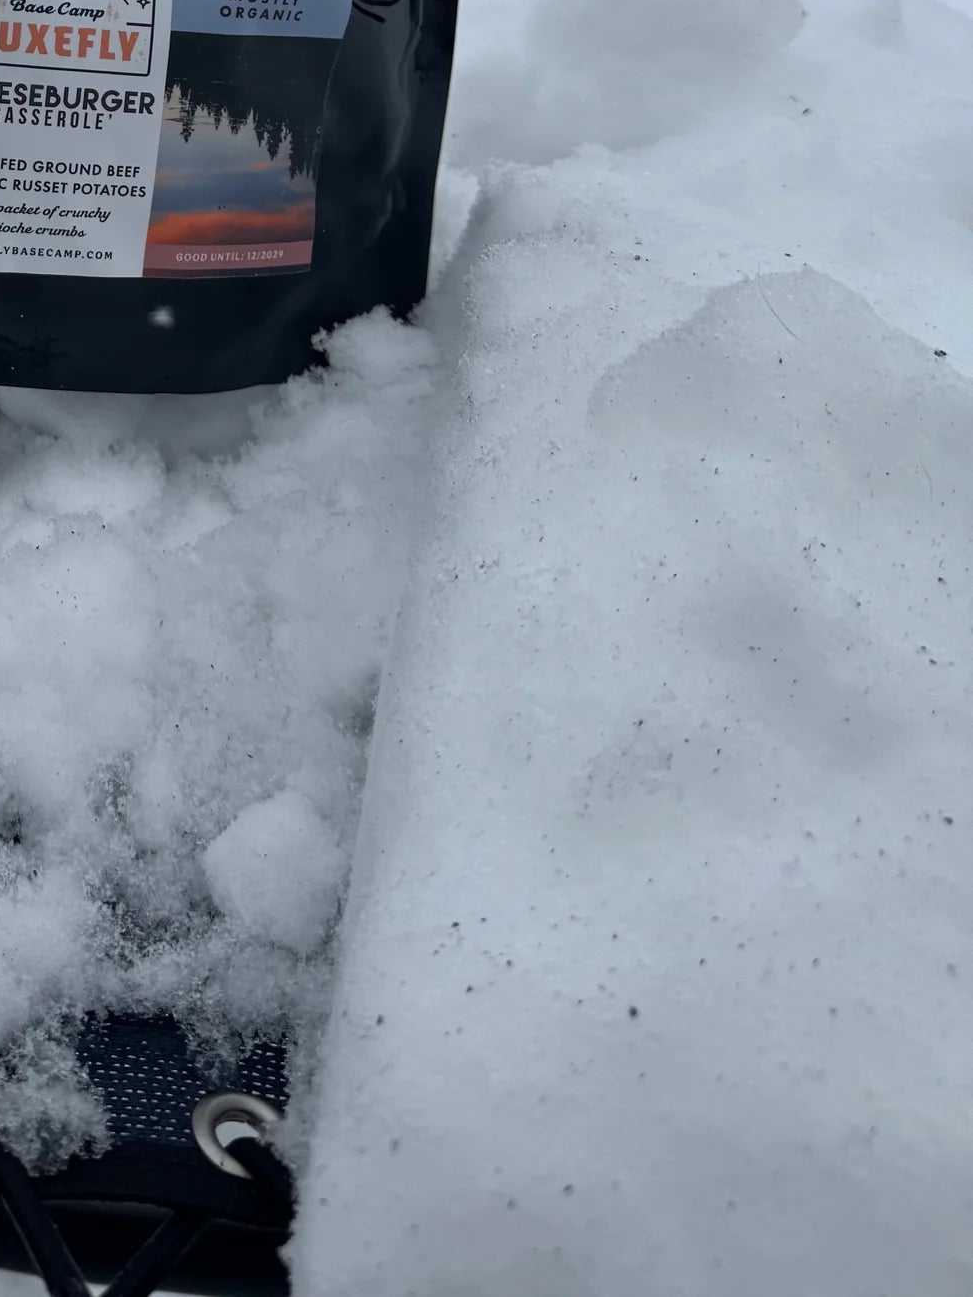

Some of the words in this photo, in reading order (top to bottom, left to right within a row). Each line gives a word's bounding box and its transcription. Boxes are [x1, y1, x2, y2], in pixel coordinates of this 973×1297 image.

[57, 2, 105, 22] Camp
[219, 5, 304, 22] ORGANIC
[0, 158, 27, 171] FED
[32, 160, 102, 176] GROUND
[107, 165, 141, 178] BEEF
[12, 179, 69, 194] RUSSET
[73, 182, 147, 198] POTATOES
[42, 205, 60, 220] of
[59, 207, 111, 223] crunchy
[35, 225, 87, 238] crumbs
[175, 252, 208, 262] GOOD
[210, 251, 245, 262] UNTIL:
[246, 249, 284, 261] 12/2029
